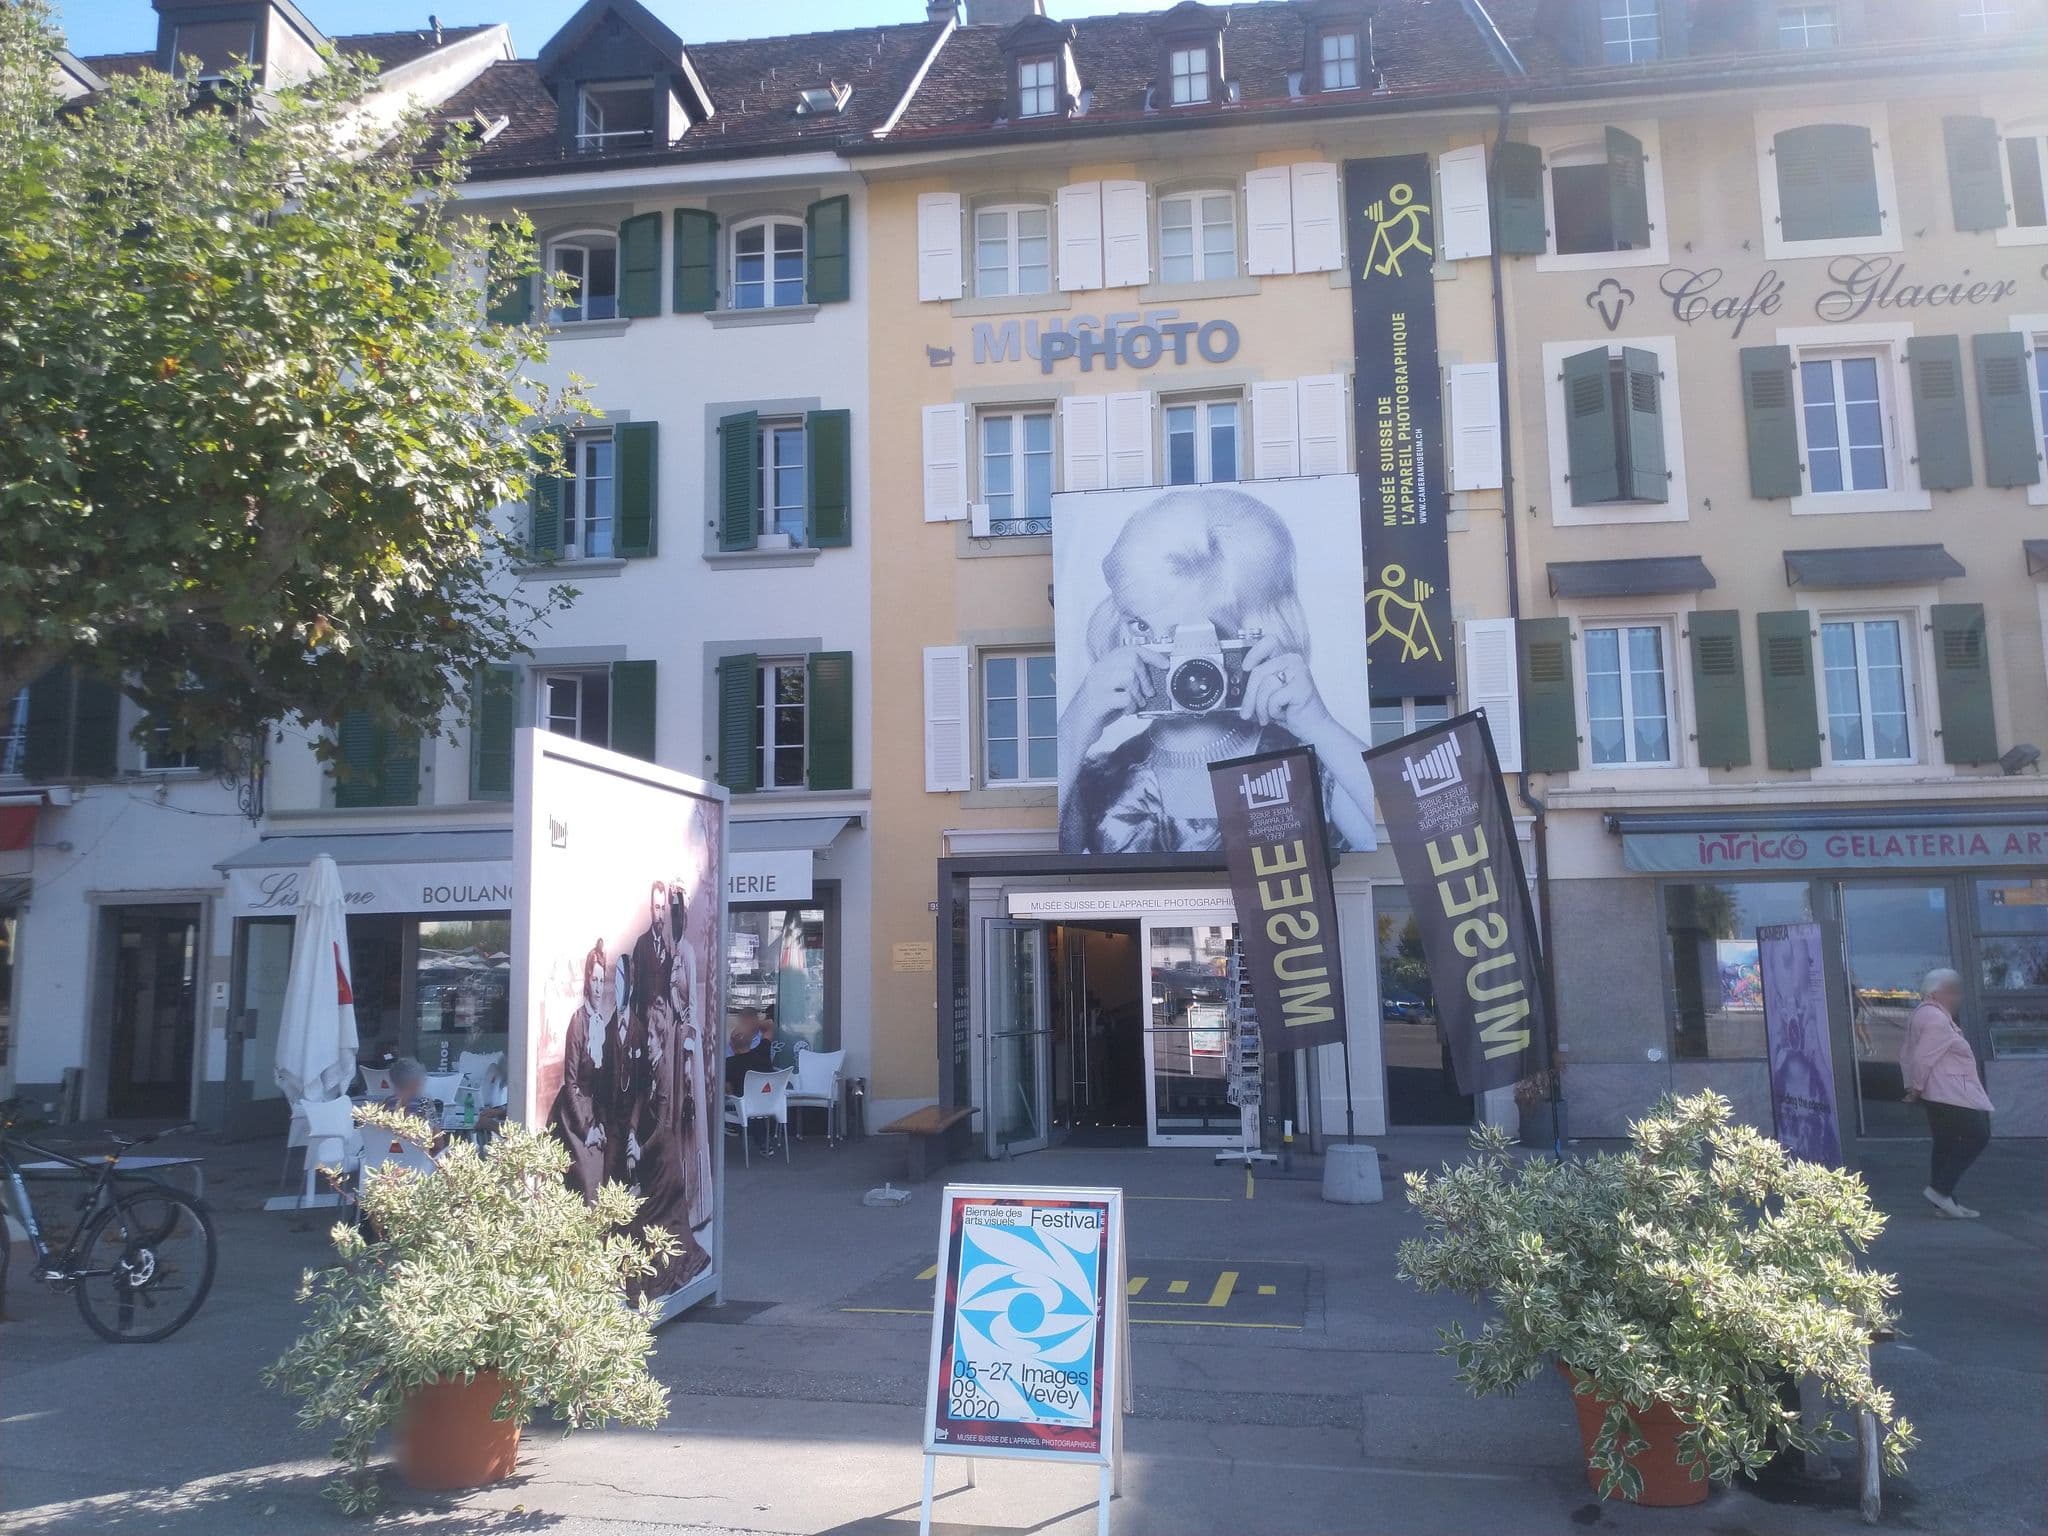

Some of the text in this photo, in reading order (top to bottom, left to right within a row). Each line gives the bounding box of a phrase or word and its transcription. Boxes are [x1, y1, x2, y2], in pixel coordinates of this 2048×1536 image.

[1659, 255, 2017, 339] Café Glacier
[1041, 319, 1240, 375] PHOTO
[1392, 312, 1415, 525] L'APPAREIL PHOTOGRAPHIQUE
[1378, 396, 1397, 526] MUSÉE SUISSE DE
[1415, 428, 1427, 524] WWW.CAMERAMUSEUM.CH
[1825, 833, 1990, 858] GELATERIA
[423, 884, 513, 904] BOULAN
[1064, 900, 1096, 910] SUISSE
[1098, 900, 1110, 909] DE
[964, 1216, 1015, 1226] arts visuels
[965, 1206, 1022, 1218] Biennale des
[1031, 1209, 1101, 1230] Festival
[1021, 1363, 1089, 1389] Images
[951, 1379, 980, 1399] 09.
[1021, 1383, 1080, 1410] Vevey
[951, 1398, 1000, 1419] 2020
[1042, 1438, 1097, 1449] PHOTOGRAPHIQUE
